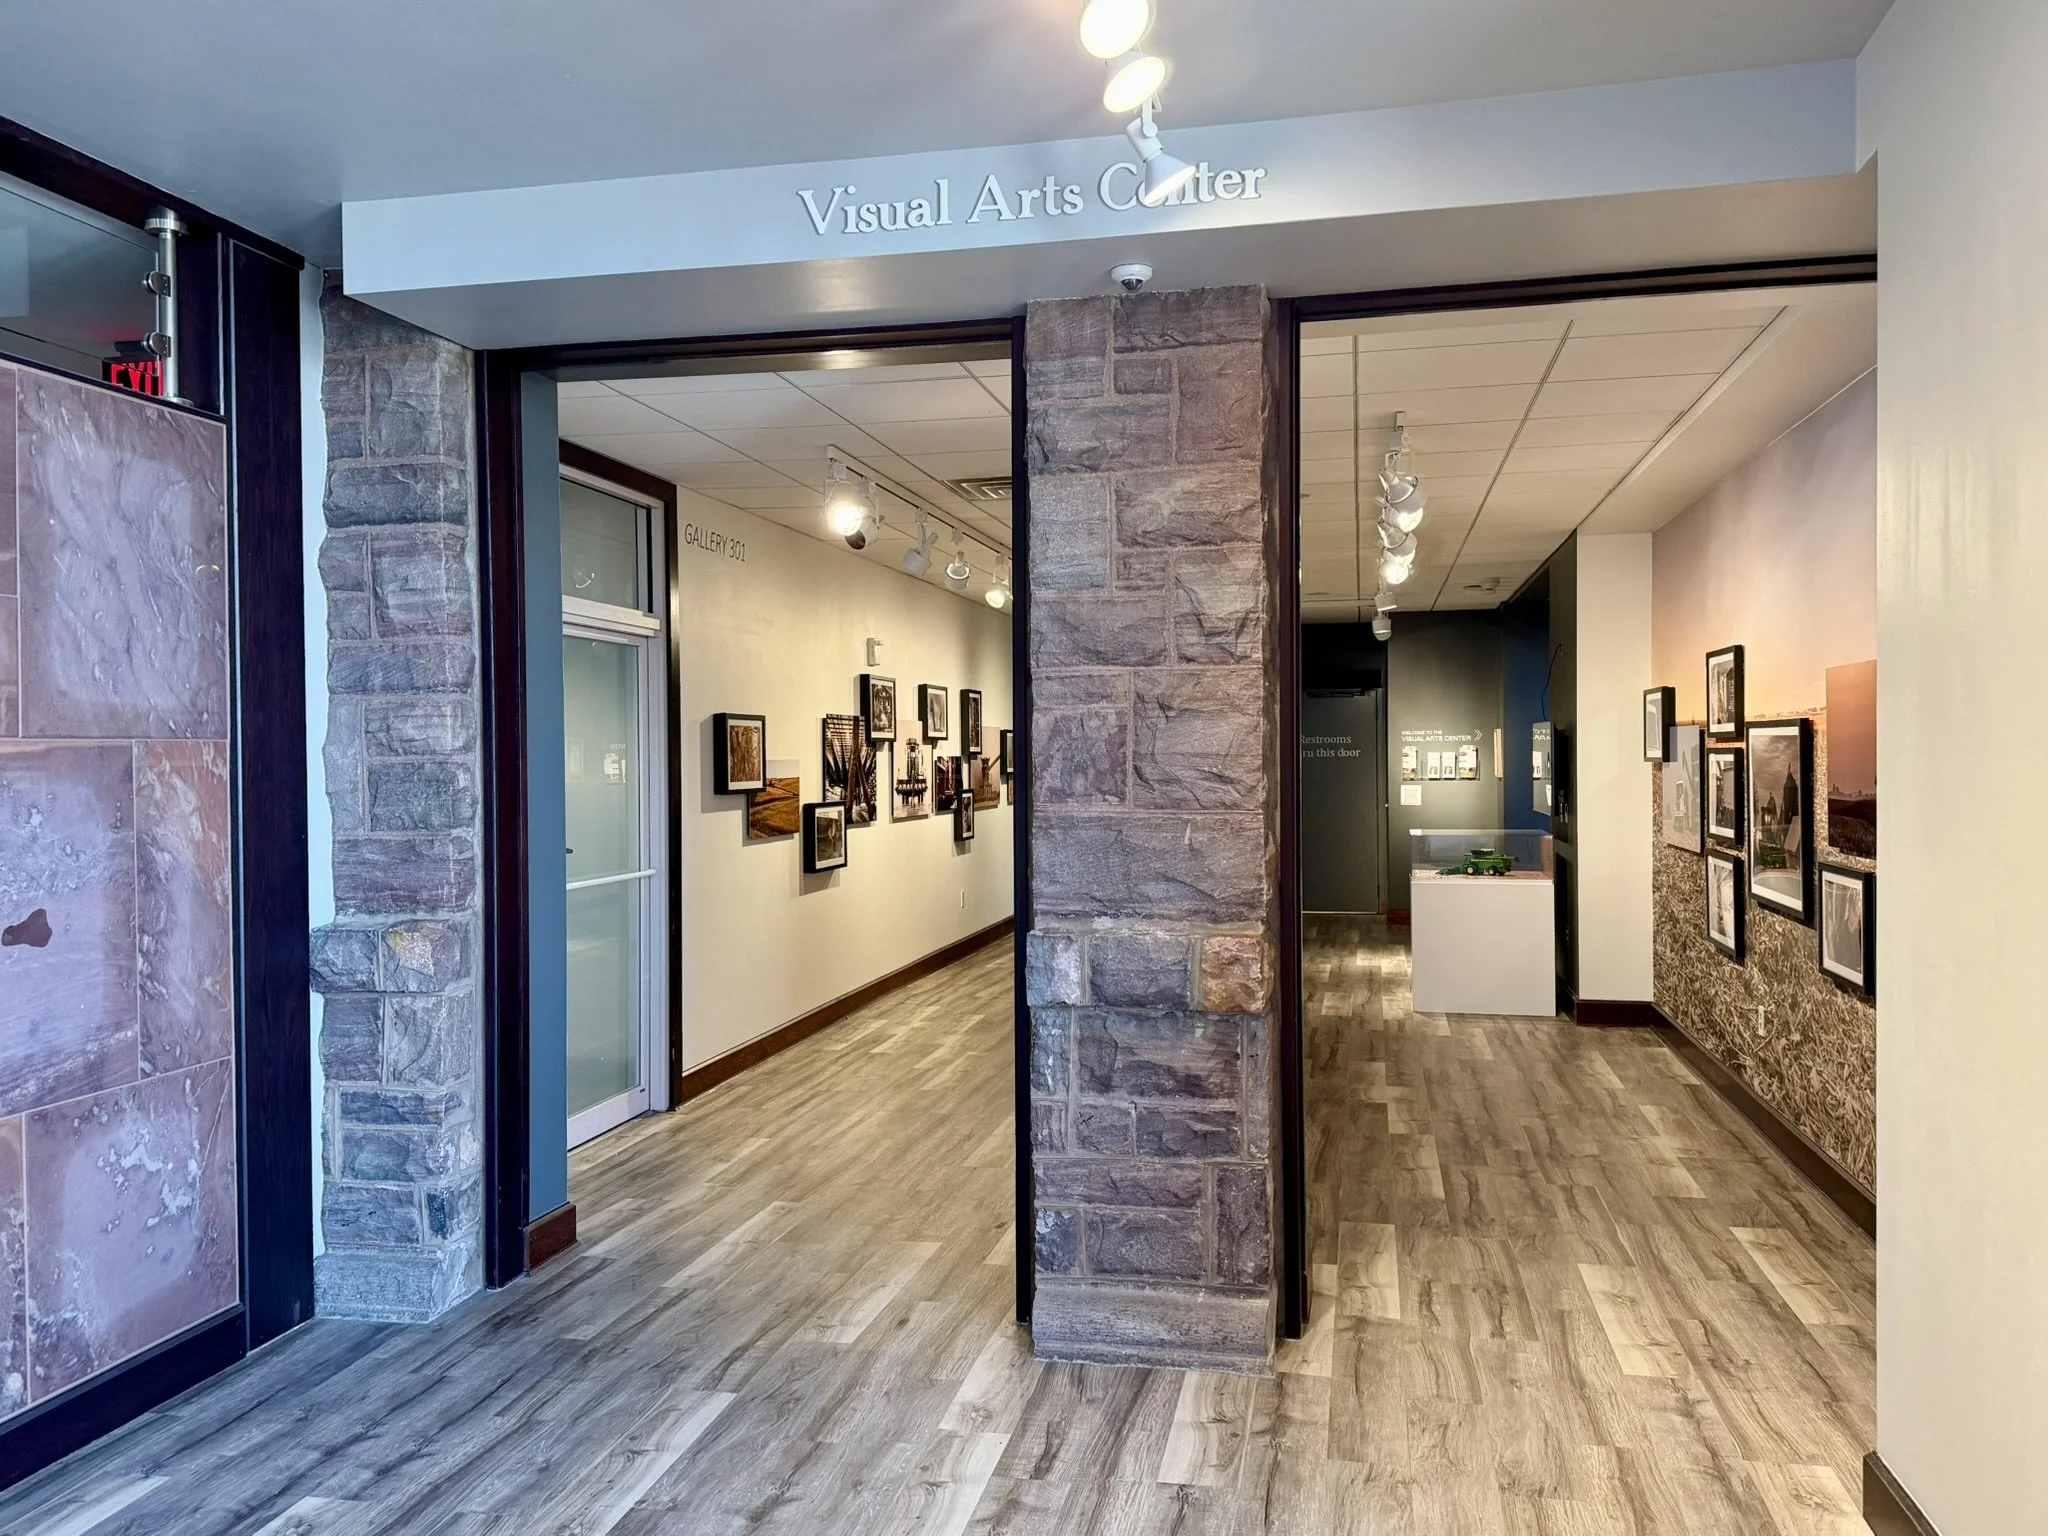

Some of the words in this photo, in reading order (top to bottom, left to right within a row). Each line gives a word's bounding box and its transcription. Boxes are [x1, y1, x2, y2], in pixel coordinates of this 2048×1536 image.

[798, 179, 953, 236] Visual
[966, 174, 1084, 223] Arts
[685, 523, 728, 556] GALLERY
[729, 538, 746, 562] 301
[1316, 748, 1335, 757] this
[1337, 747, 1361, 757] door
